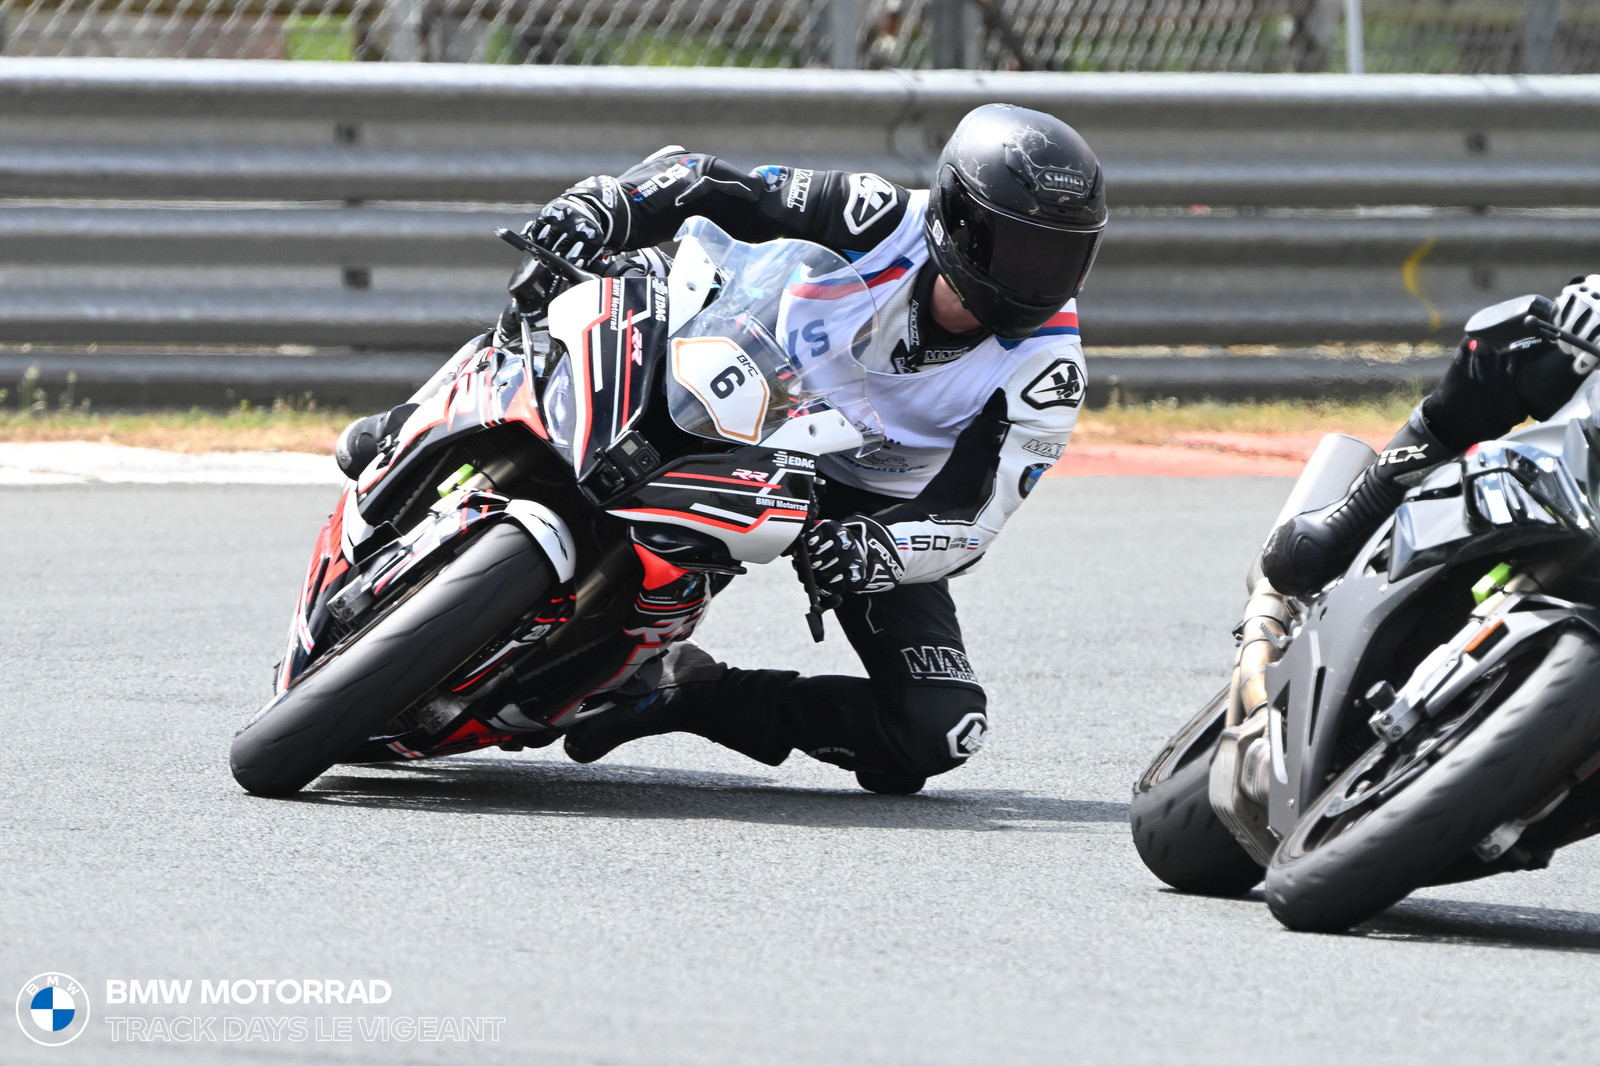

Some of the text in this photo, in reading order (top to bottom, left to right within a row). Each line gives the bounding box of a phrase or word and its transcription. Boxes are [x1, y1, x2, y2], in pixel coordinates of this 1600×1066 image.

[610, 278, 620, 331] BMW Motorrad
[710, 365, 746, 400] 6
[788, 455, 815, 469] EDAG
[1378, 443, 1429, 466] TCX
[731, 468, 770, 484] RR
[755, 497, 808, 511] BMW Motorrad
[910, 535, 951, 551] 50
